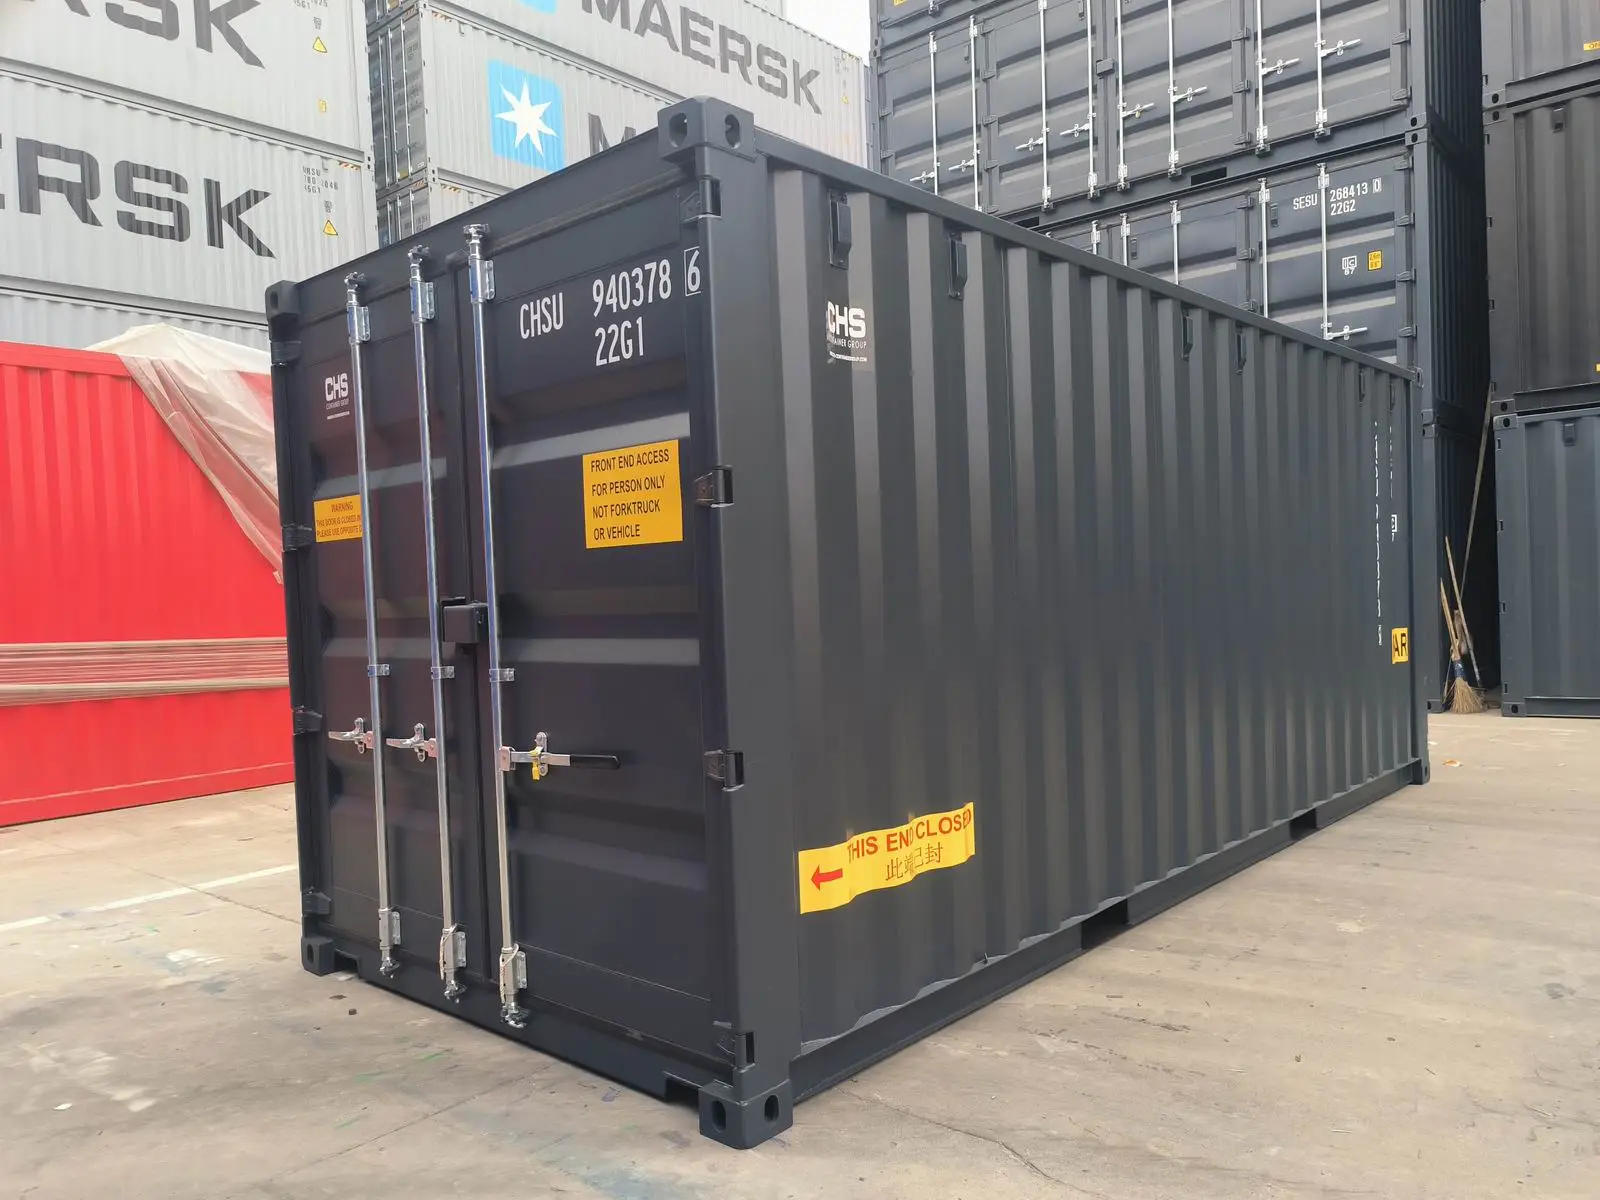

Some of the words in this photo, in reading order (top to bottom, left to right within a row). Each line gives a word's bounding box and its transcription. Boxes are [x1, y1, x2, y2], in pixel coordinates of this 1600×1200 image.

[0, 133, 276, 259] RSK
[1293, 193, 1318, 210] SESU
[1329, 182, 1368, 202] 268413
[1330, 200, 1356, 216] 22G2
[519, 292, 564, 340] CHSU
[592, 258, 672, 318] 940378
[687, 249, 701, 293] 6
[826, 301, 866, 339] CHS
[594, 316, 644, 367] 22G1
[325, 372, 349, 402] CHS
[590, 457, 616, 473] FRONT
[618, 454, 635, 469] END
[636, 448, 670, 466] ACCESS
[591, 483, 608, 497] FOR
[609, 478, 643, 494] PERSON
[643, 474, 666, 491] ONLY
[592, 504, 608, 519] NOT
[610, 499, 661, 517] FORKTRUCK
[593, 527, 605, 541] OR
[606, 523, 641, 540] VEHICLE
[848, 835, 879, 865] THIS
[886, 826, 915, 853] END
[915, 808, 972, 840] CLOSED
